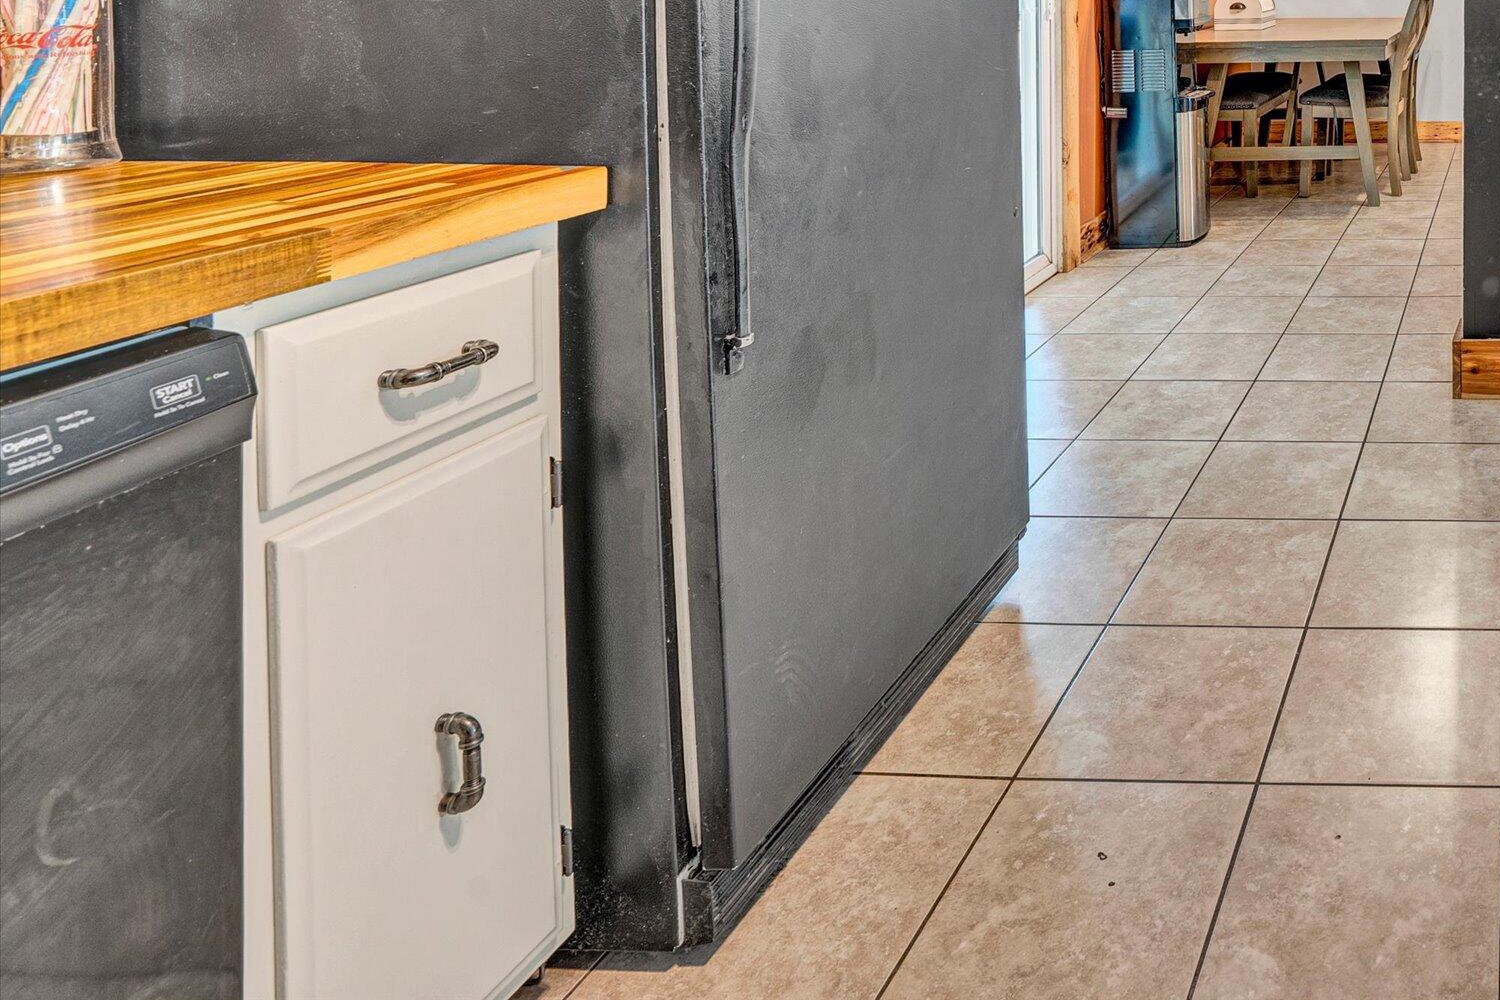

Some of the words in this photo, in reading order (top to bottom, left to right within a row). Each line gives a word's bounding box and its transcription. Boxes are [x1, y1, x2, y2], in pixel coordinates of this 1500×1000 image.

[155, 378, 194, 399] START
[162, 388, 193, 404] Cancel
[2, 433, 48, 453] Options
